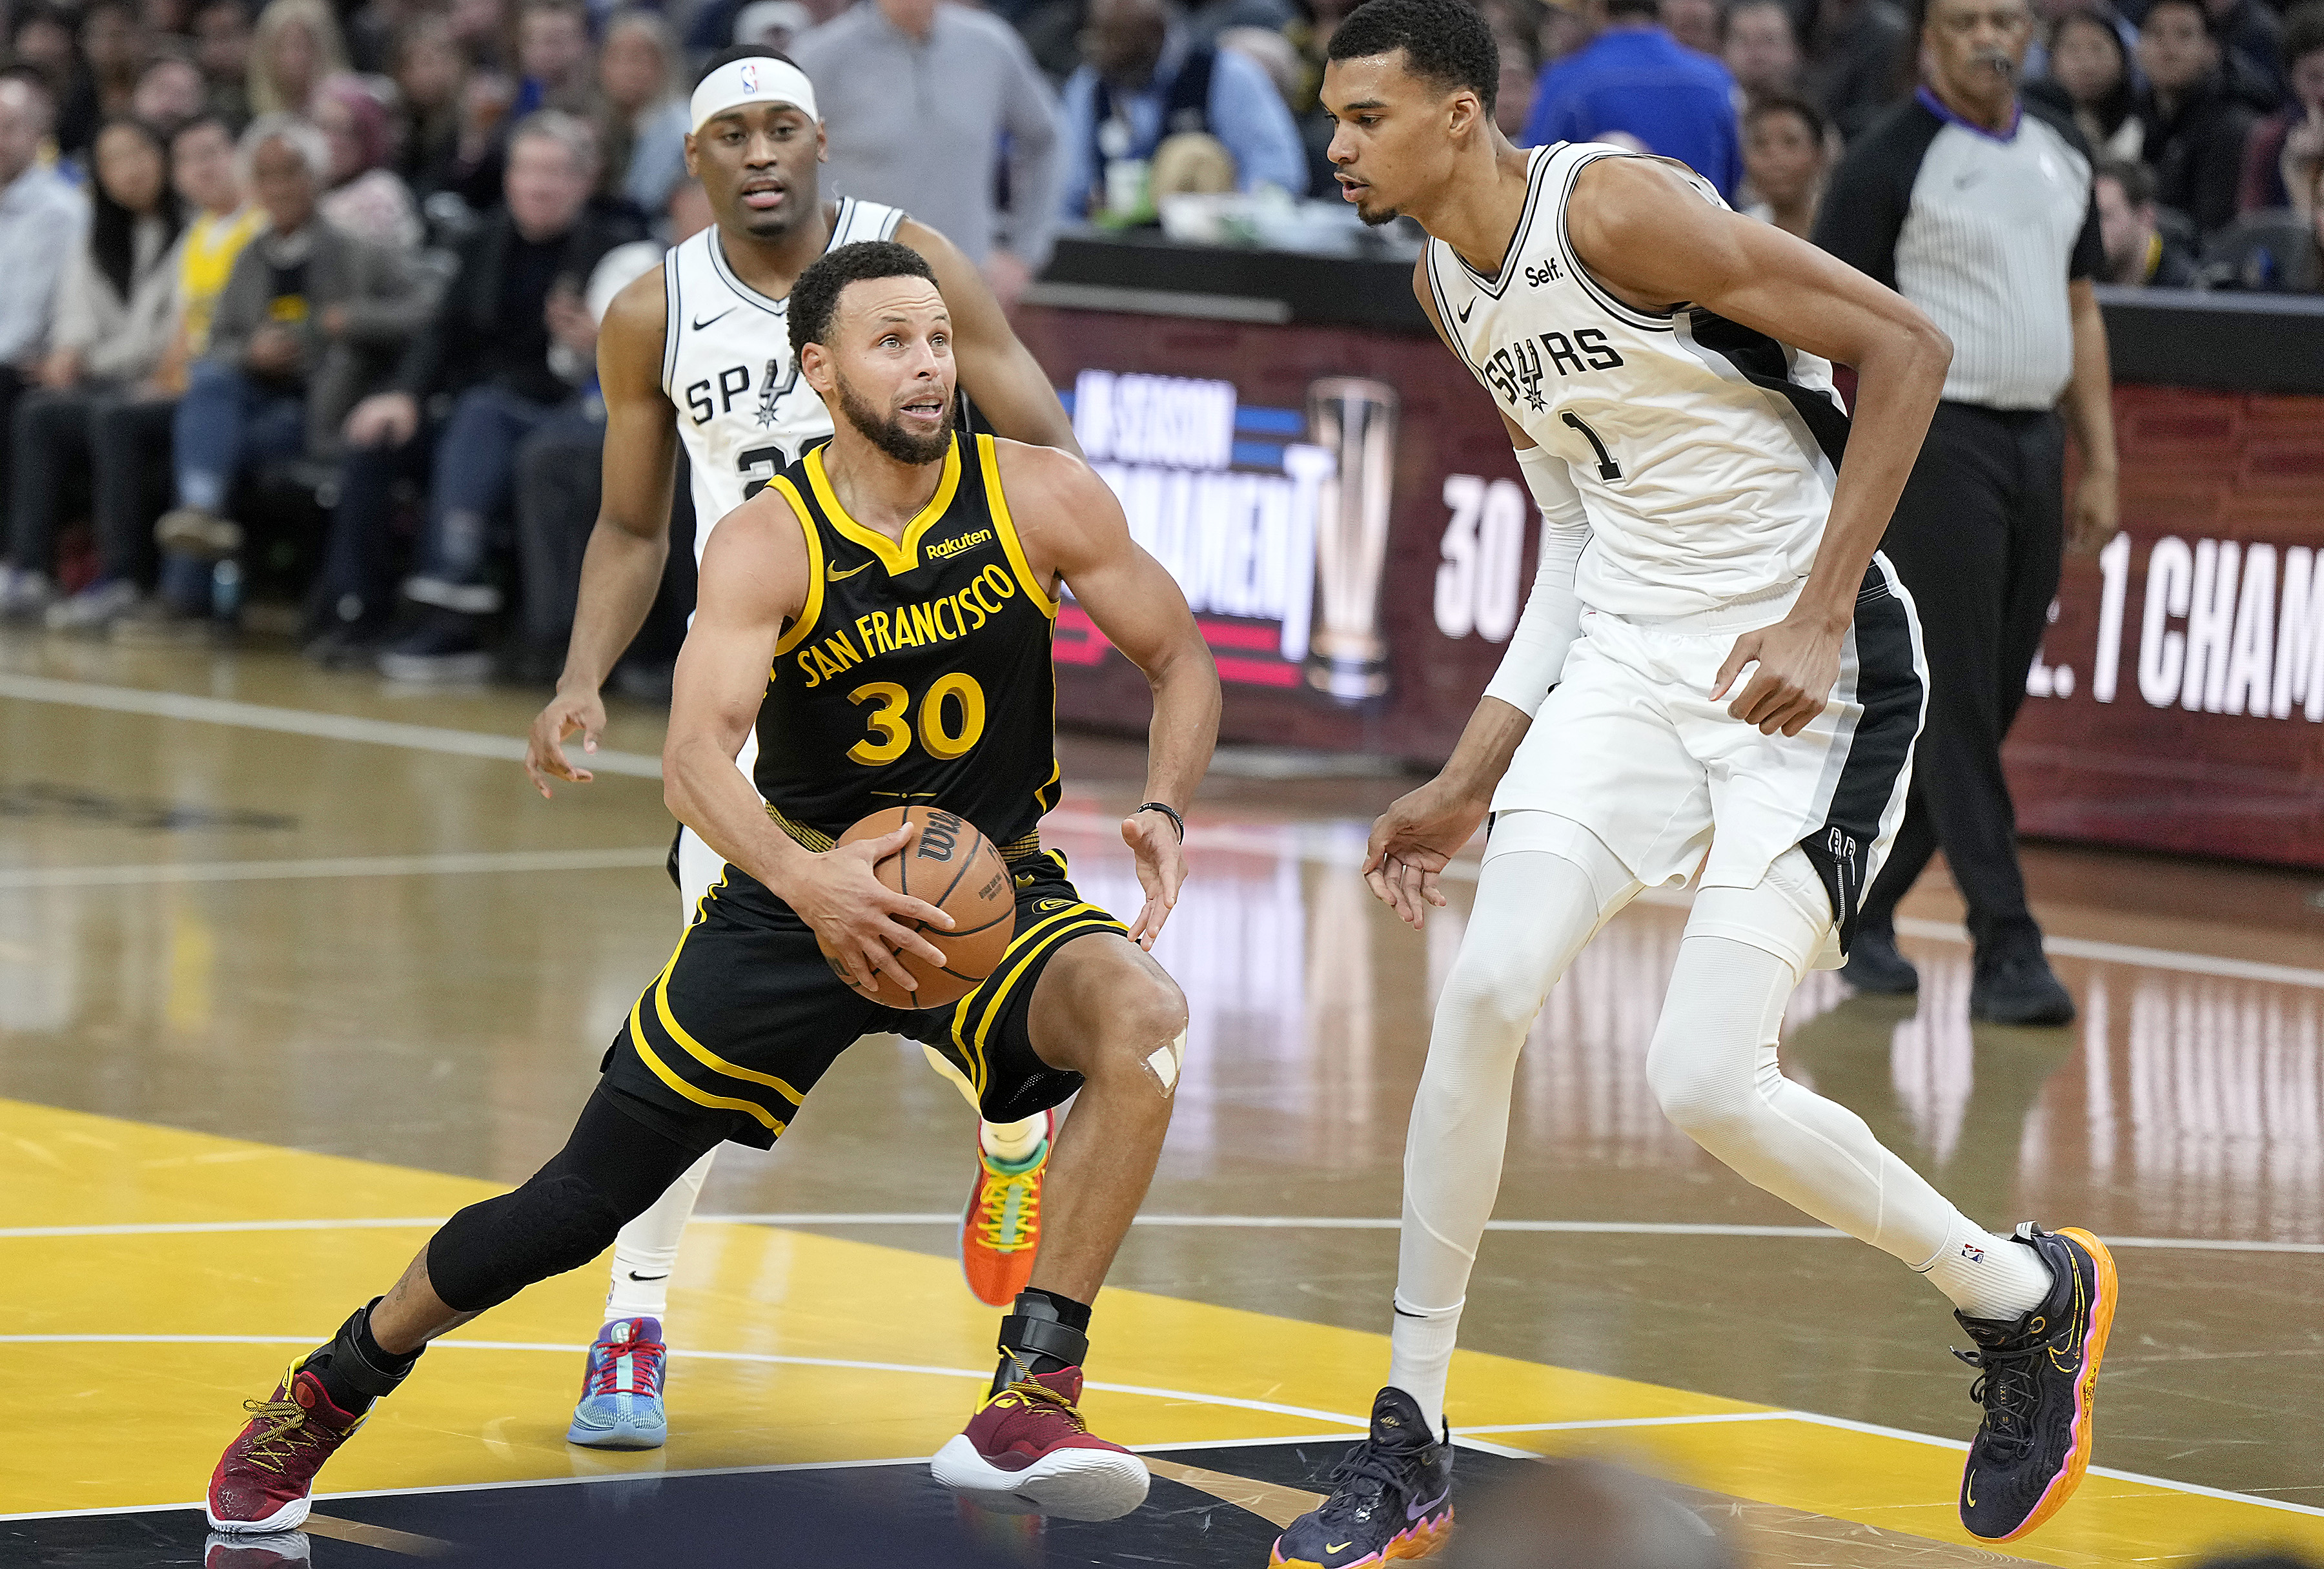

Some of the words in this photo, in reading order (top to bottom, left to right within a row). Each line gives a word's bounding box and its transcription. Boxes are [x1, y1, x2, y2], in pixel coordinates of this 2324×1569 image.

[1525, 256, 1564, 288] Self.
[1484, 328, 1624, 415] SPURS
[1558, 408, 1626, 484] 1
[925, 528, 992, 560] Rakuten
[1434, 474, 1527, 643] 30
[797, 630, 863, 688] SAN
[855, 564, 1015, 659] FRANCISCO
[2094, 531, 2130, 704] 1
[846, 672, 986, 766] 30
[915, 811, 963, 863] Wil
